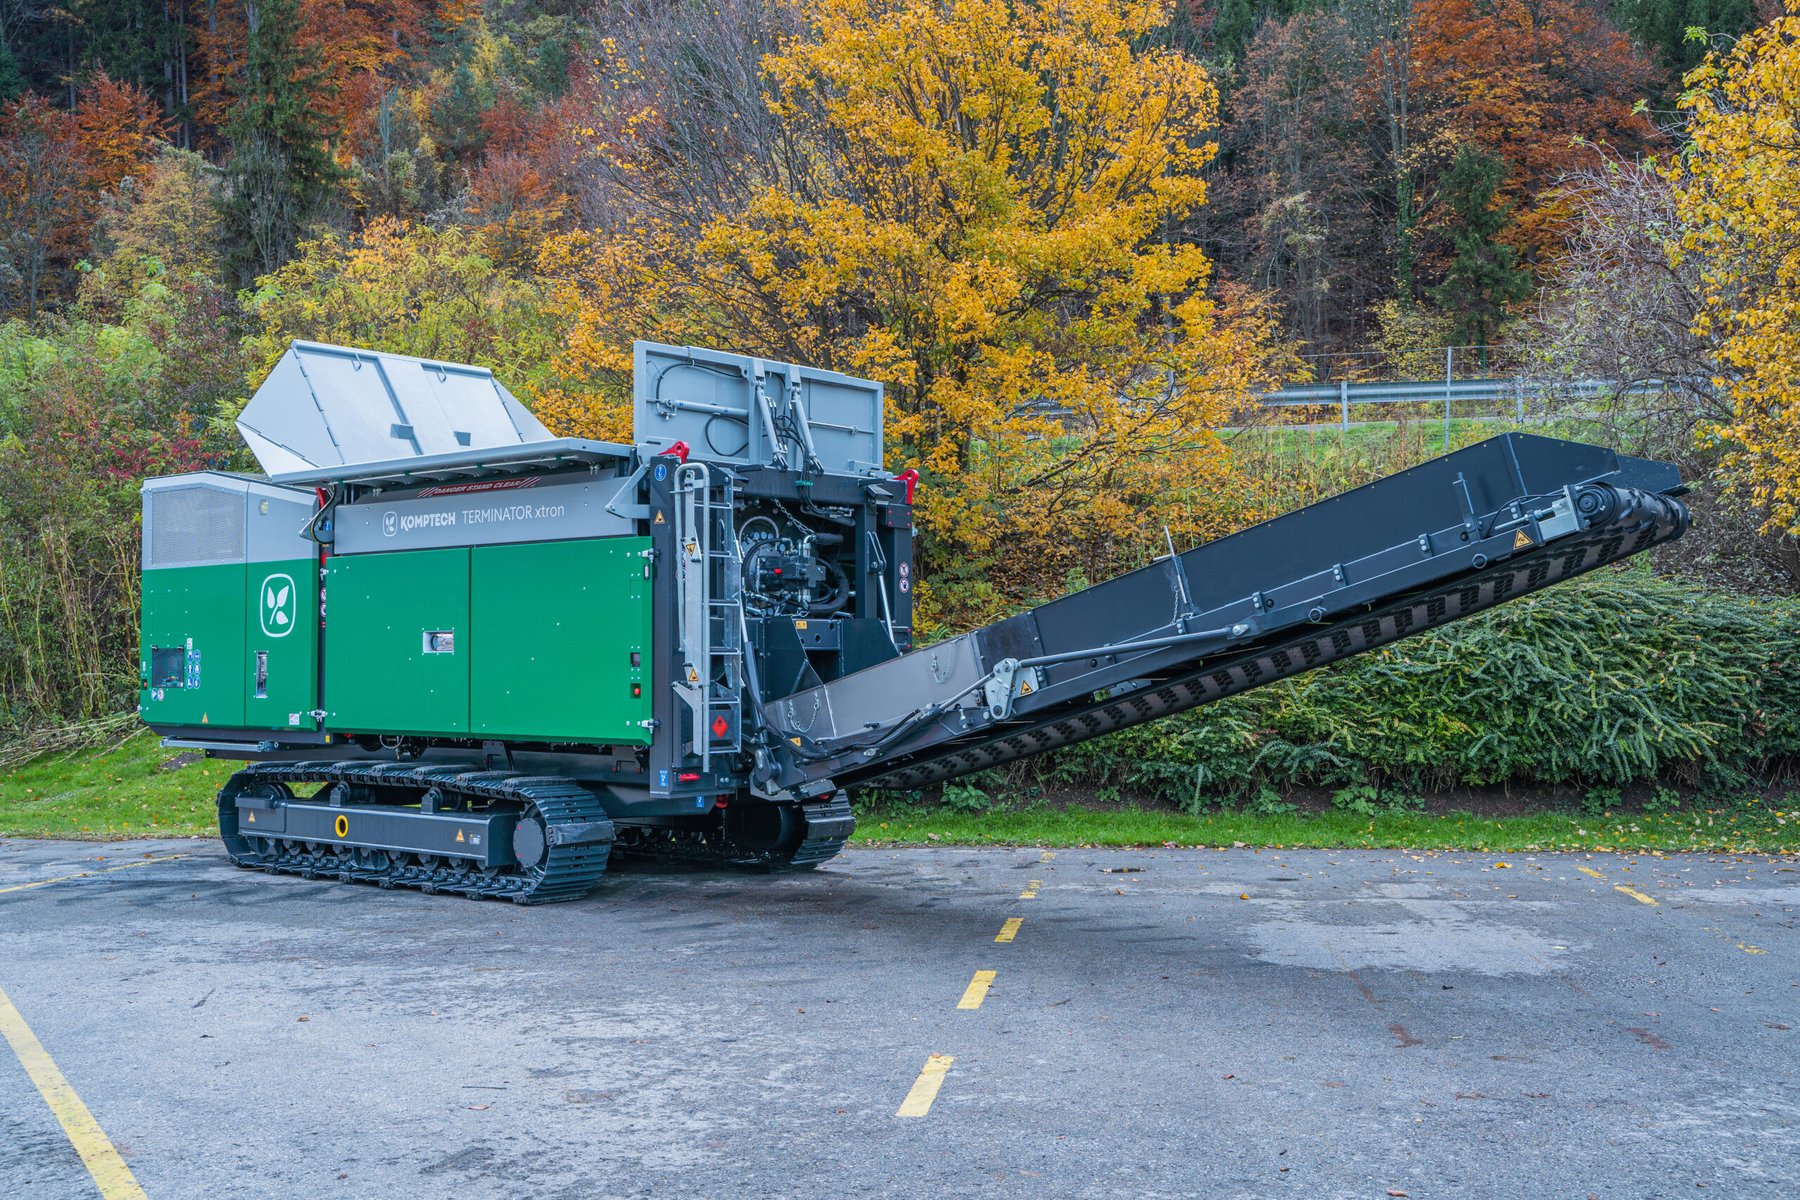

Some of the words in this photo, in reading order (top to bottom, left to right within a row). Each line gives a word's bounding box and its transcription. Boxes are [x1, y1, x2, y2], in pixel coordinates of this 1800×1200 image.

[435, 486, 465, 494] DANGER
[466, 483, 493, 491] STAND
[494, 480, 520, 489] CLEAR
[400, 512, 456, 531] KOMPTECH
[462, 505, 532, 524] TERMINATOR
[534, 505, 565, 518] xtron
